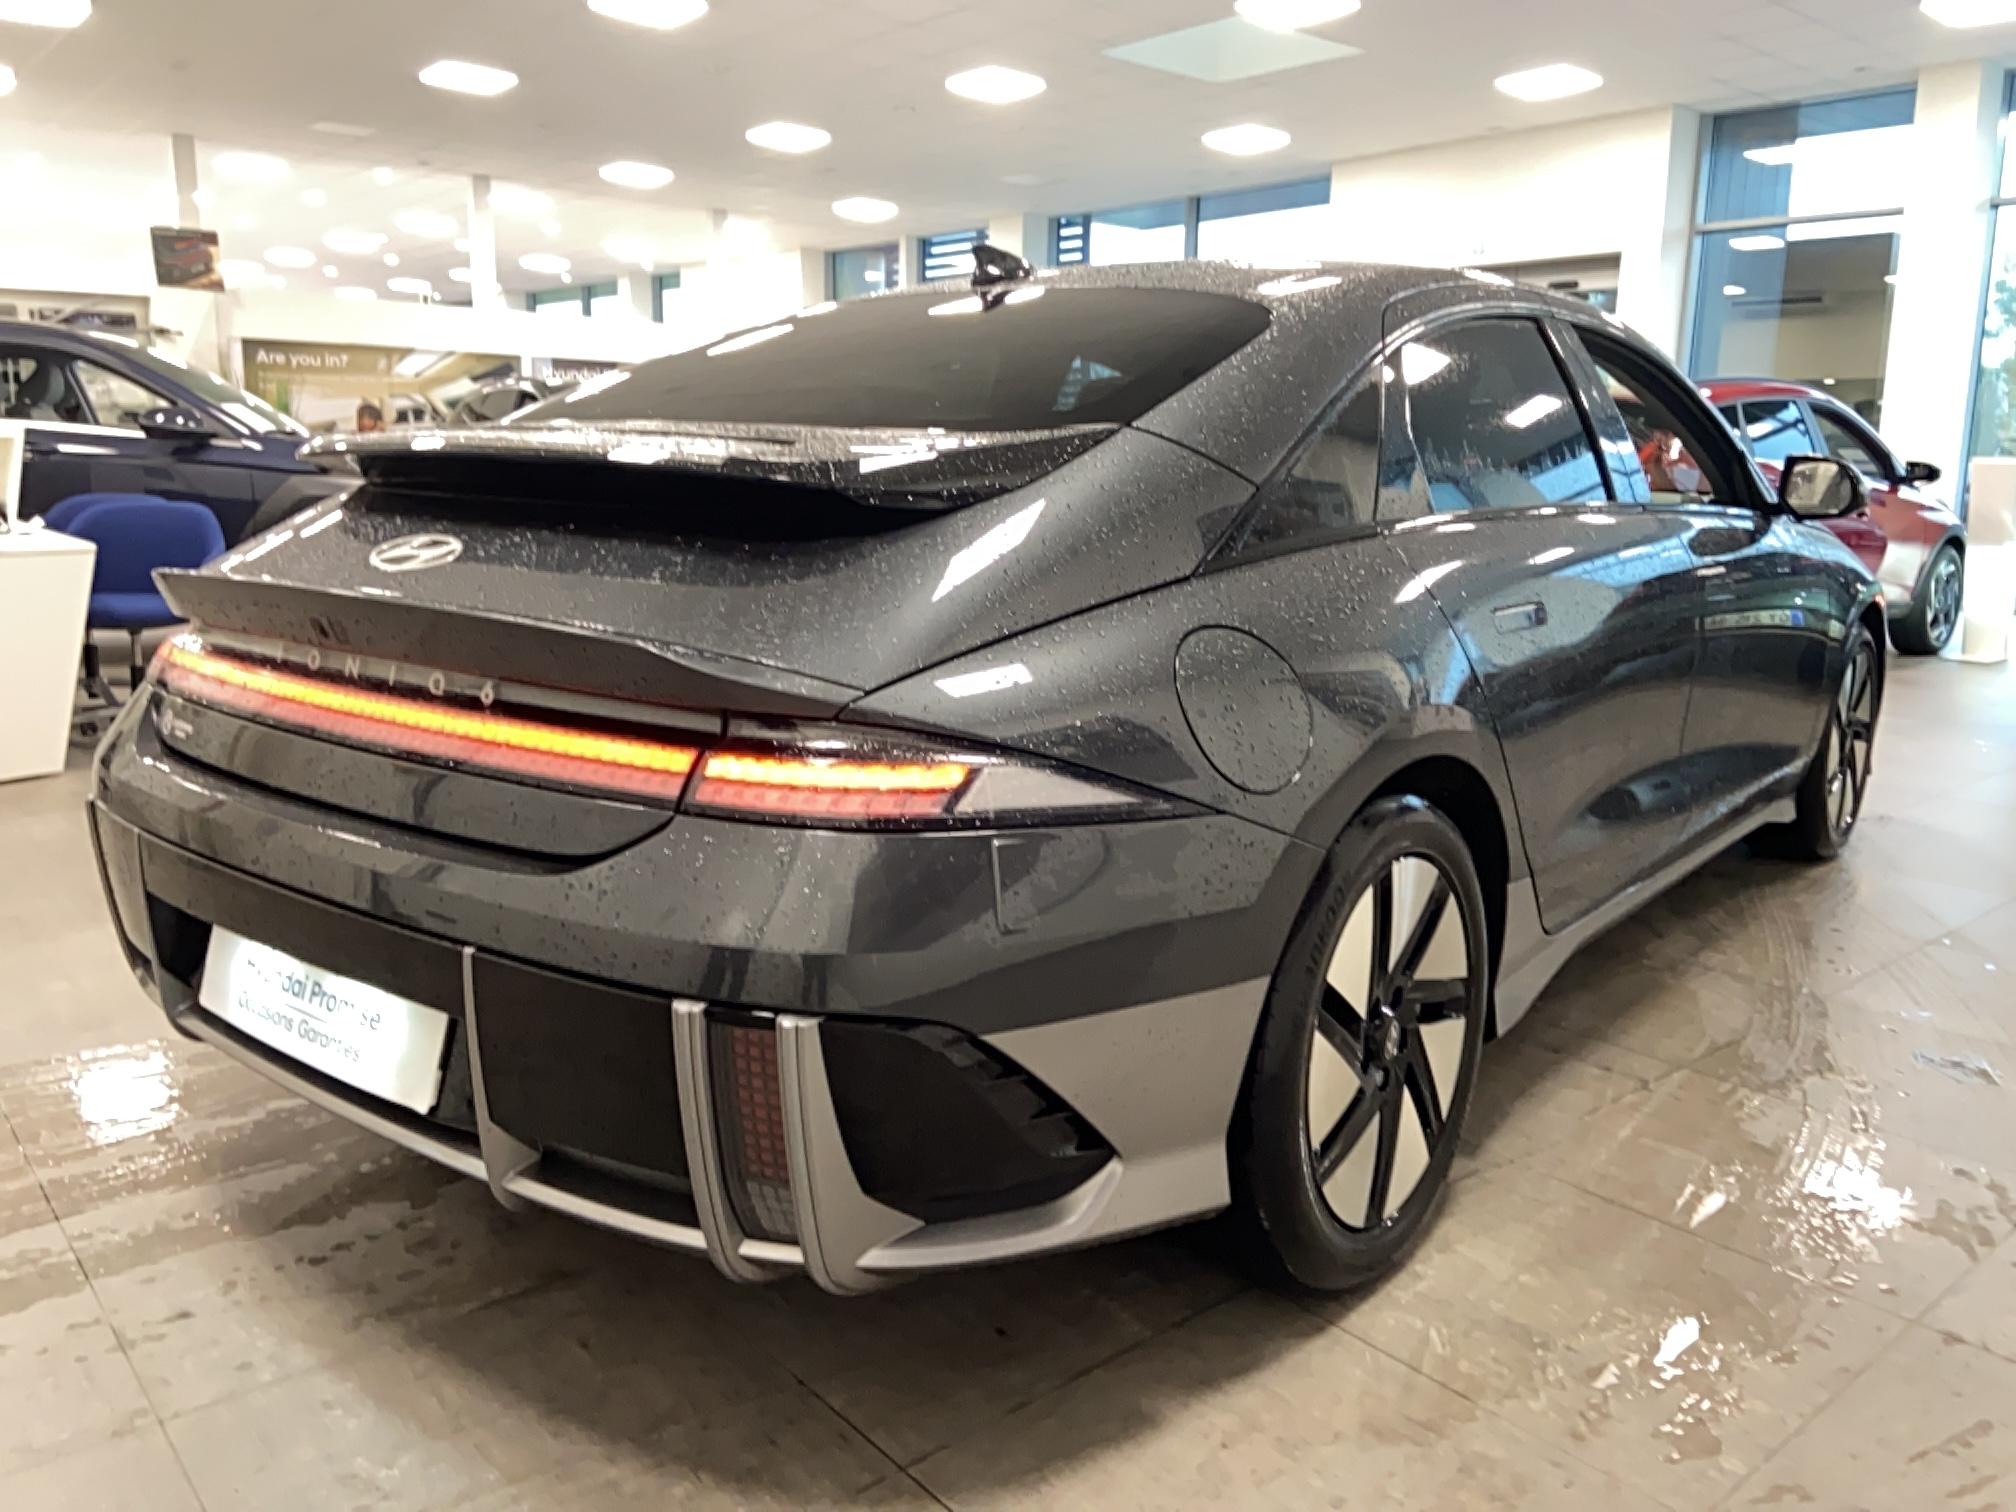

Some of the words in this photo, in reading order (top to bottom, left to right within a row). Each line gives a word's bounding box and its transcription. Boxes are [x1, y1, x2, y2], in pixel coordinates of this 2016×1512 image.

[256, 347, 286, 365] Are
[289, 353, 321, 369] you
[277, 642, 445, 696] IONIQ
[480, 680, 495, 706] 6
[309, 978, 381, 1031] Prose
[298, 1018, 361, 1063] Garaes
